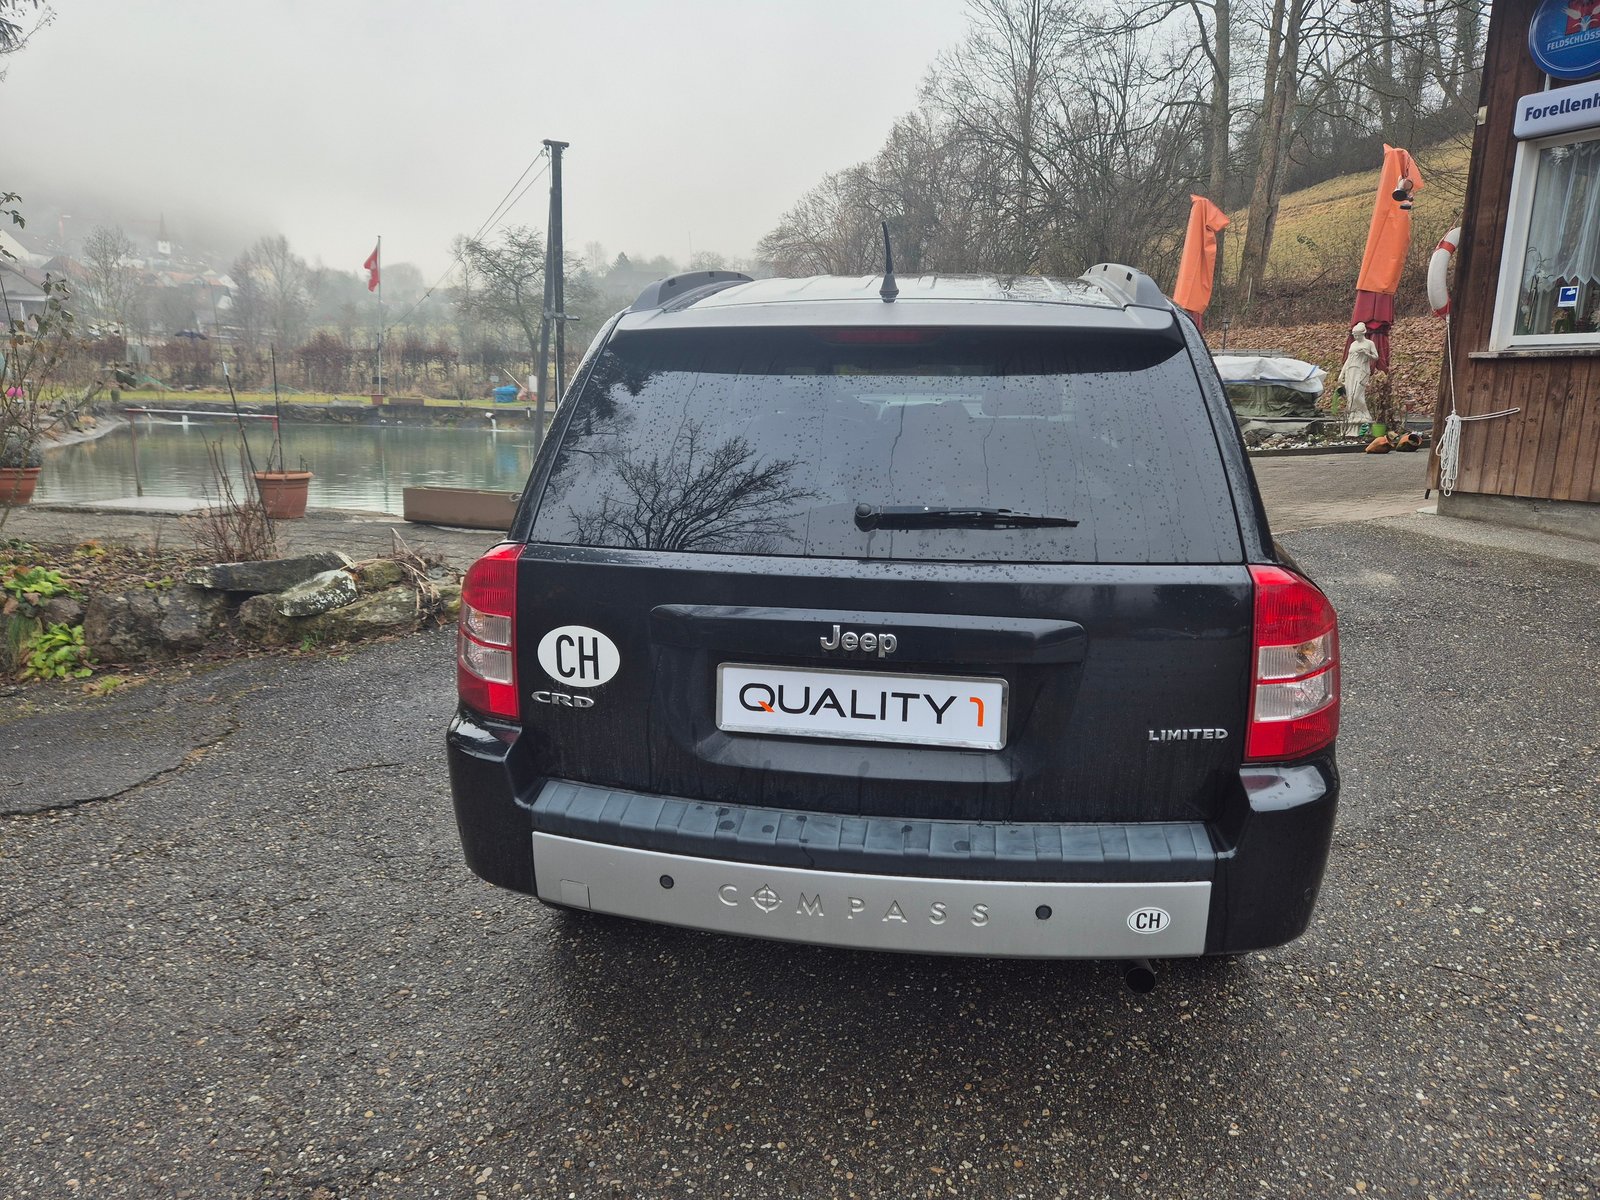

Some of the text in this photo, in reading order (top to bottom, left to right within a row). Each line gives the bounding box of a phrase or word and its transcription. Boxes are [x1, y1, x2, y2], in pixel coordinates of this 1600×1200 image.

[820, 624, 898, 657] Jeep
[556, 635, 600, 680] CH
[531, 691, 594, 708] CRD
[739, 683, 957, 725] QUALITY
[1149, 728, 1229, 742] LIMITED
[717, 883, 990, 928] COMPASS
[1136, 909, 1161, 930] CH
